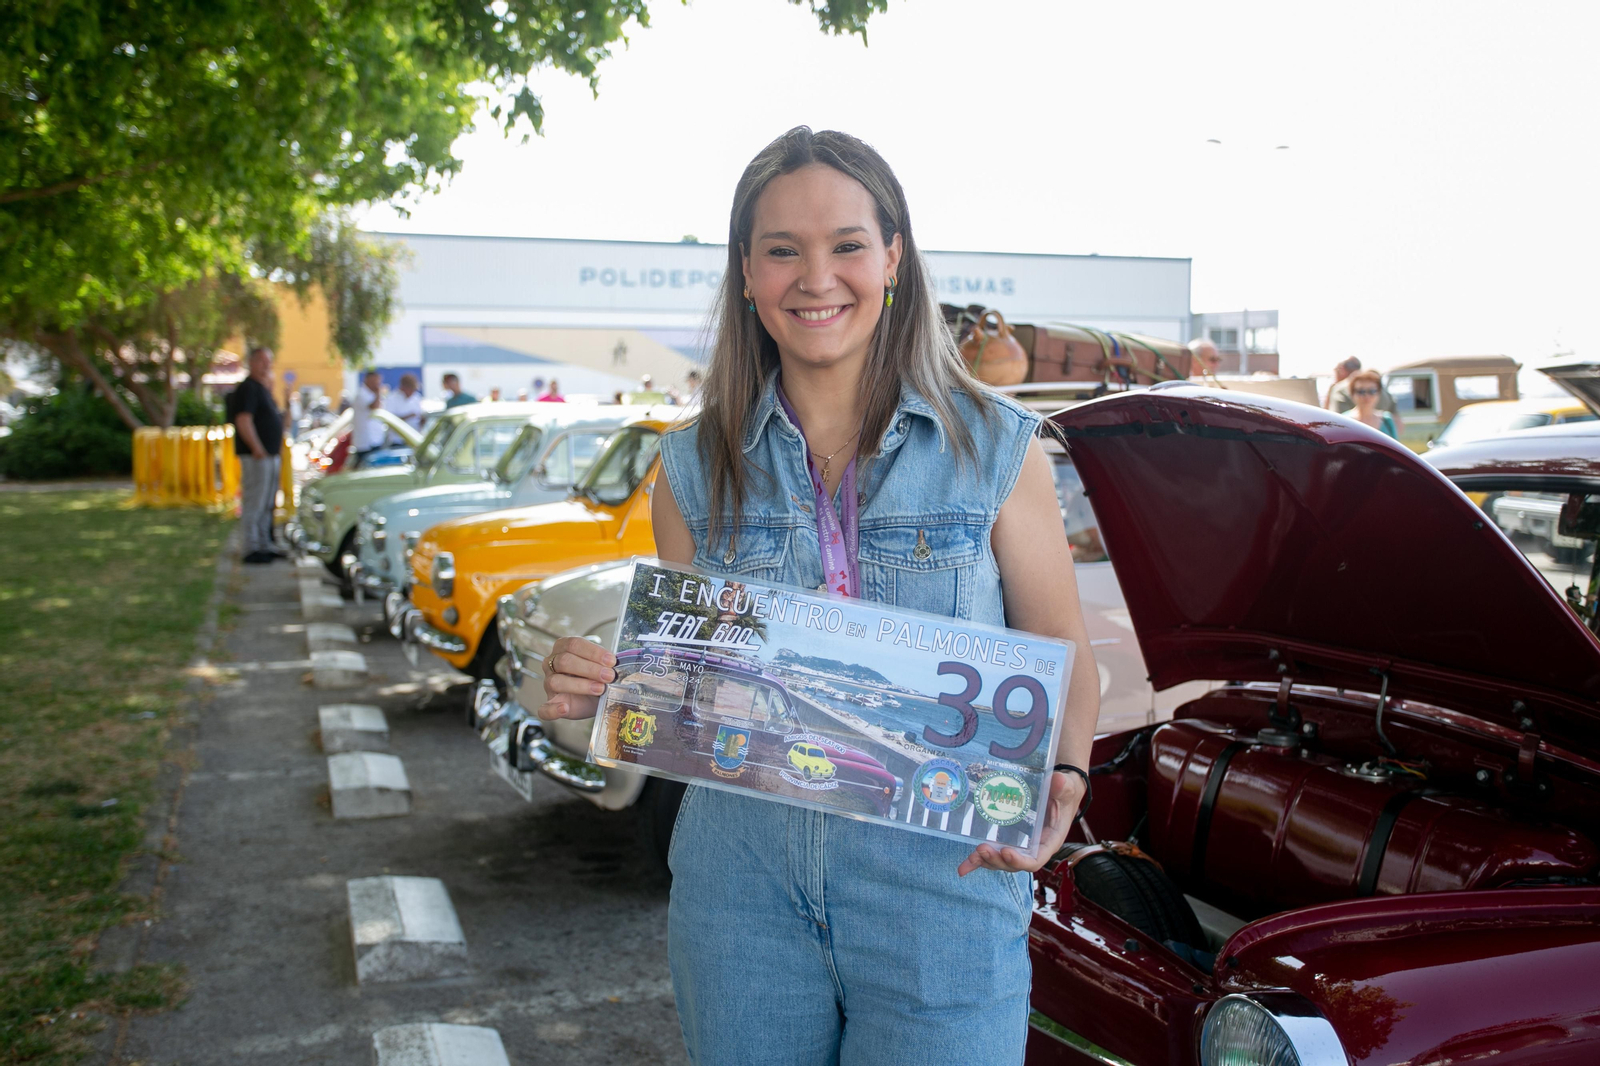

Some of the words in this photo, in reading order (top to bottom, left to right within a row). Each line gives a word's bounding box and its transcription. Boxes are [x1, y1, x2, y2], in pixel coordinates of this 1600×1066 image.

[579, 266, 721, 289] POLIDEPO
[932, 275, 1016, 296] ISMAS
[648, 573, 666, 598] I
[679, 579, 843, 634] ENCUENTRO
[845, 621, 868, 639] EN
[876, 617, 1028, 671] PALMONES
[1034, 658, 1057, 677] DE
[651, 611, 709, 640] SEAT
[710, 622, 754, 645] 600
[639, 653, 671, 679] 25
[680, 662, 704, 675] MAYO
[676, 675, 701, 684] 2024
[922, 661, 1050, 761] 39
[784, 734, 808, 743] AMIGOS
[808, 734, 820, 742] DEL
[930, 759, 960, 772] ESCAPE
[986, 760, 1017, 771] MIEMBRO
[779, 770, 809, 788] PROVINCIA
[810, 782, 820, 790] DE
[925, 801, 948, 812] LIBRE
